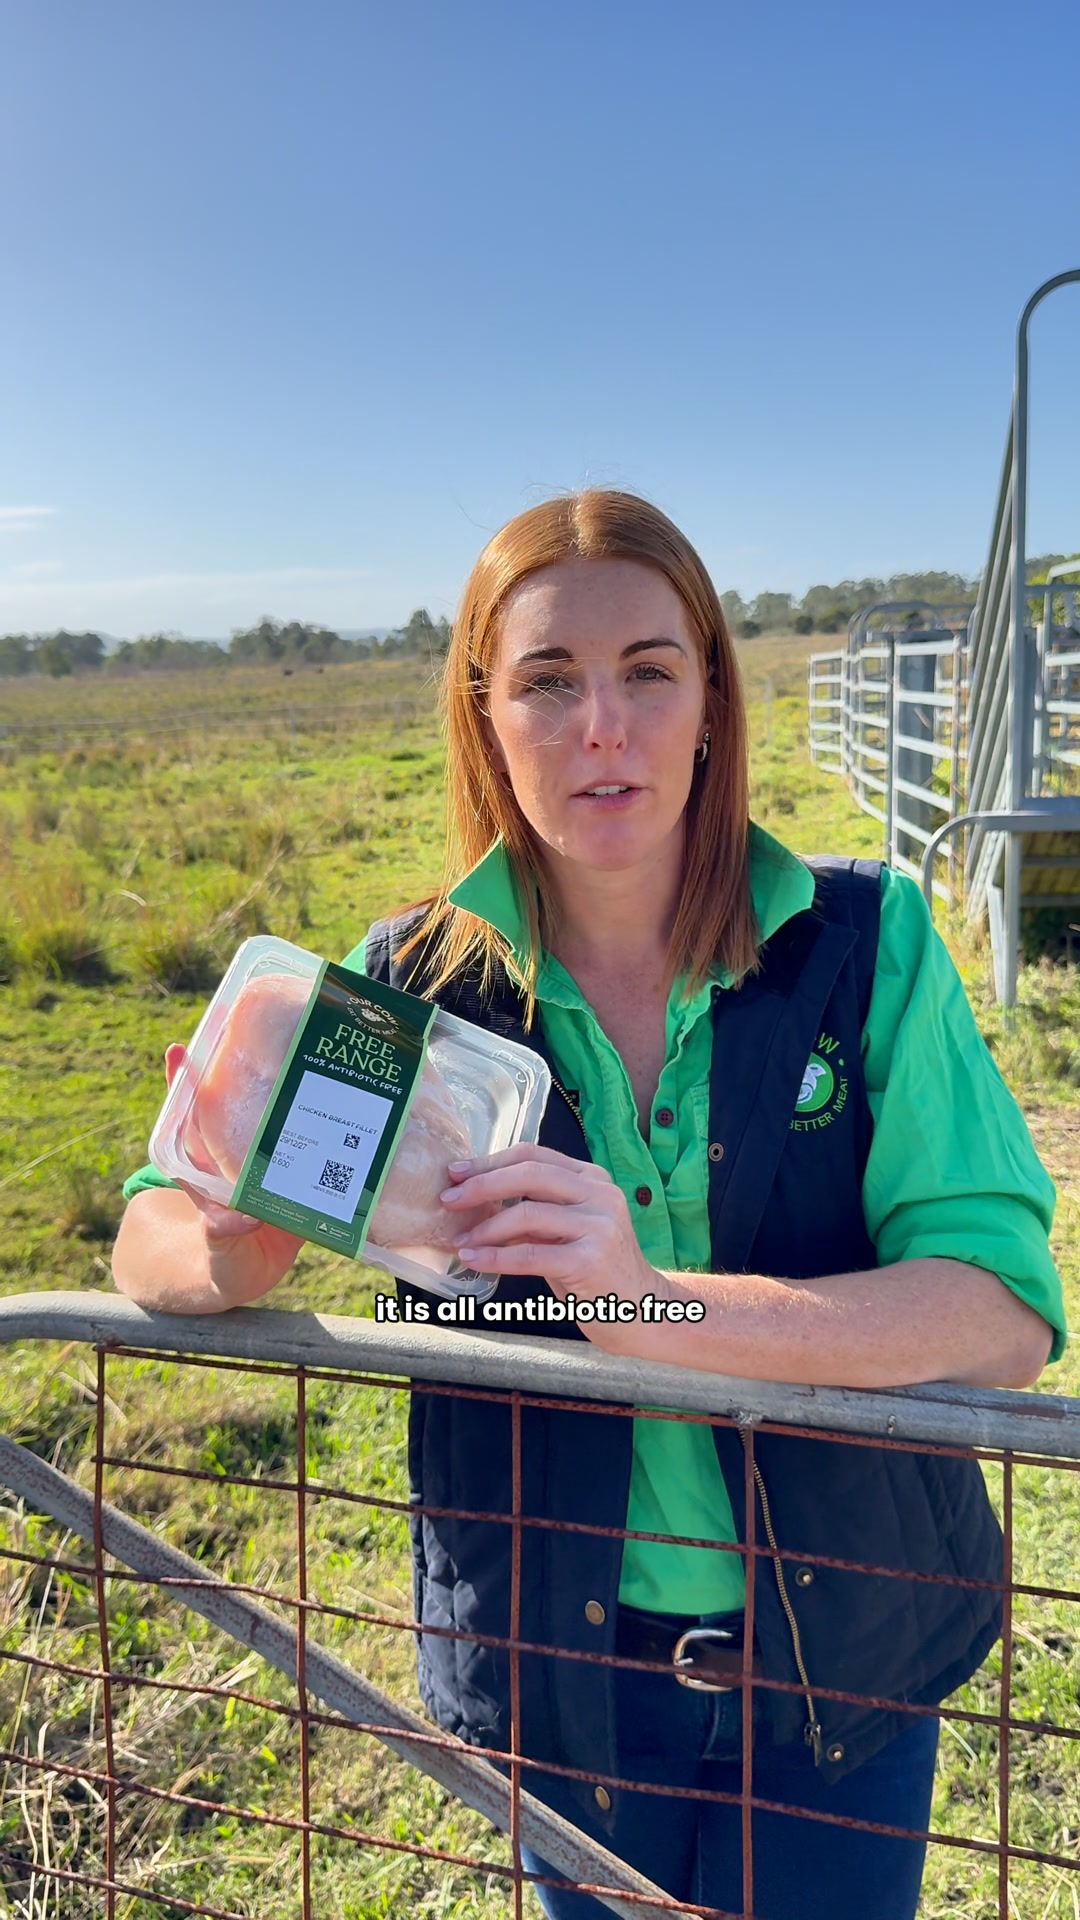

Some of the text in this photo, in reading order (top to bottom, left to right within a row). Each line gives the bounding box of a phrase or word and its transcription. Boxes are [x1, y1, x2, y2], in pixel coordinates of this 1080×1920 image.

[349, 997, 399, 1027] OUR COW
[354, 1017, 381, 1035] BETTER
[334, 1023, 396, 1061] FREE
[817, 1032, 840, 1054] W
[303, 1054, 403, 1095] 100% ANTIBIOTIC FREE
[315, 1036, 402, 1083] RANGE
[832, 1075, 848, 1113] MEAT
[298, 1104, 378, 1135] CHICKEN BREAST FILLET
[280, 1135, 308, 1151] 29/12/27
[282, 1128, 320, 1147] BEST BEFORE
